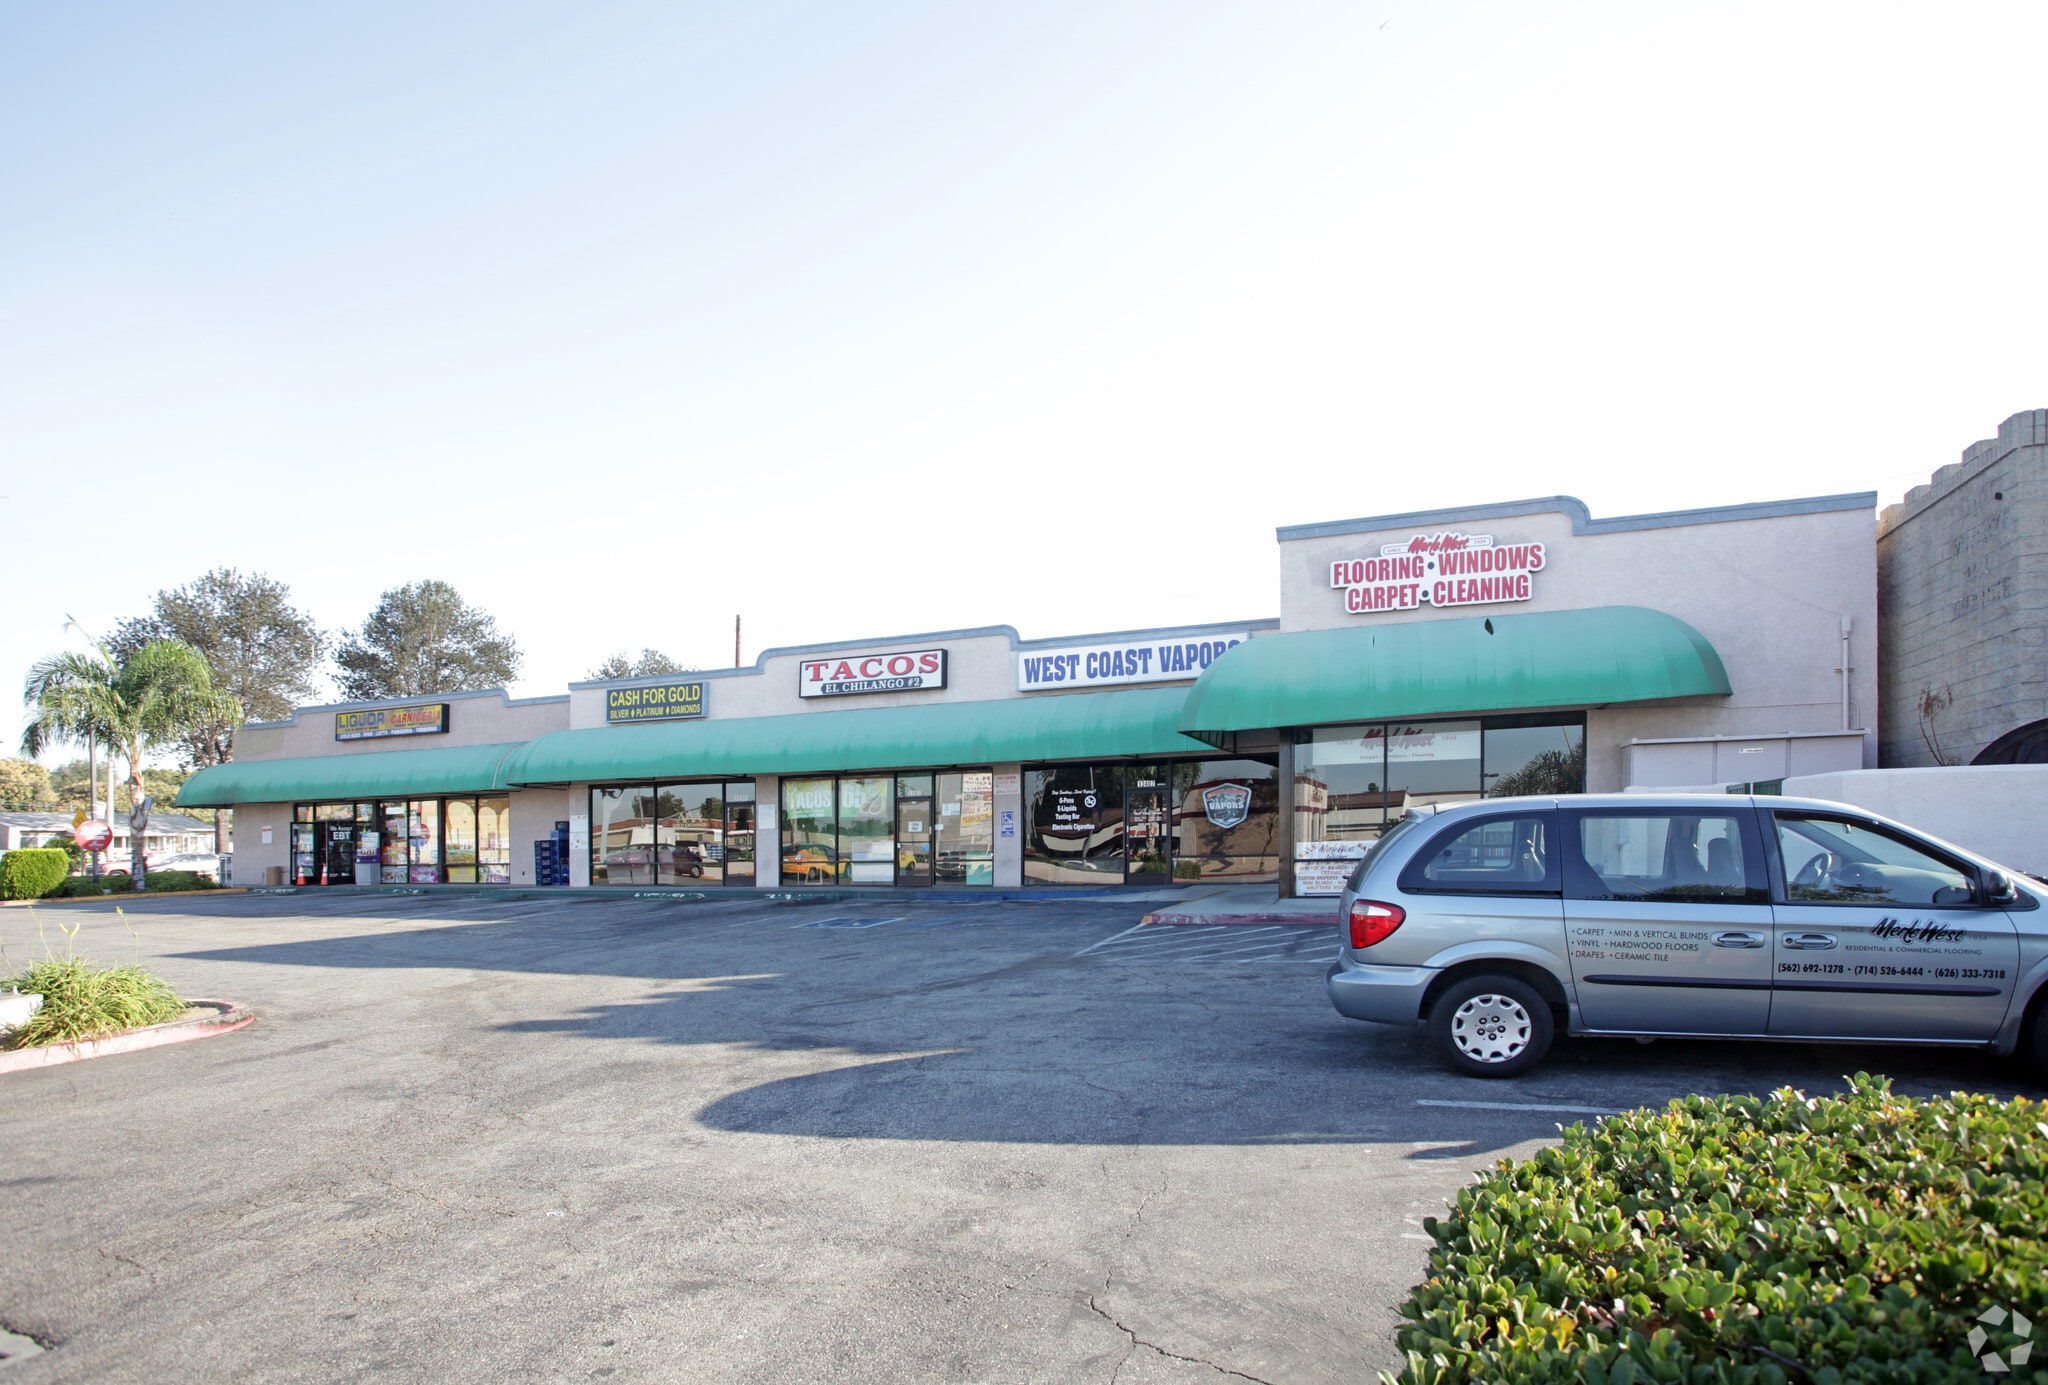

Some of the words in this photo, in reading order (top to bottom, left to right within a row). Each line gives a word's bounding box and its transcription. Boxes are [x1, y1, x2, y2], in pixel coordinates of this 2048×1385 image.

[1334, 555, 1424, 585] FLOORING
[1438, 544, 1542, 576] WINDOWS
[1348, 583, 1420, 611] CARPET
[1433, 574, 1529, 604] CLEANING
[804, 653, 939, 682] TACOS
[1024, 653, 1080, 683] WEST
[1086, 648, 1153, 679] COAST
[1158, 639, 1241, 673] VAPOR
[825, 683, 840, 693] EL
[842, 678, 904, 692] CHILANGO
[907, 677, 920, 687] #2
[610, 690, 640, 707] CASH
[642, 687, 666, 704] FOR
[668, 685, 701, 703] GOLD
[339, 712, 385, 729] LIQUOR
[390, 710, 441, 725] CARNICERIA
[610, 709, 629, 719] SILVER
[636, 706, 664, 717] PLATINUM
[671, 704, 701, 714] DIAMONDS
[788, 787, 832, 809] TACOS
[1209, 800, 1244, 810] VAPORS
[1055, 813, 1071, 821] Tasting
[333, 831, 351, 840] EBT
[1576, 927, 1605, 936] CARPET
[1634, 930, 1640, 938] &
[1641, 930, 1678, 940] VERTICAL
[1680, 932, 1708, 941] BLINDS
[1576, 939, 1600, 948] VINYL
[1609, 941, 1663, 950] HARDWOOD
[1665, 943, 1699, 951] FLOORS
[1575, 950, 1605, 959] DRAPES
[1614, 952, 1651, 961] CERAMIC
[1778, 963, 1801, 974] (562)
[1802, 964, 1844, 974] 692-1278
[1854, 965, 1878, 976] (714)
[1880, 966, 1923, 976] 526-6444
[1934, 967, 1959, 978] (626)
[1961, 968, 2006, 979] 333-7318
